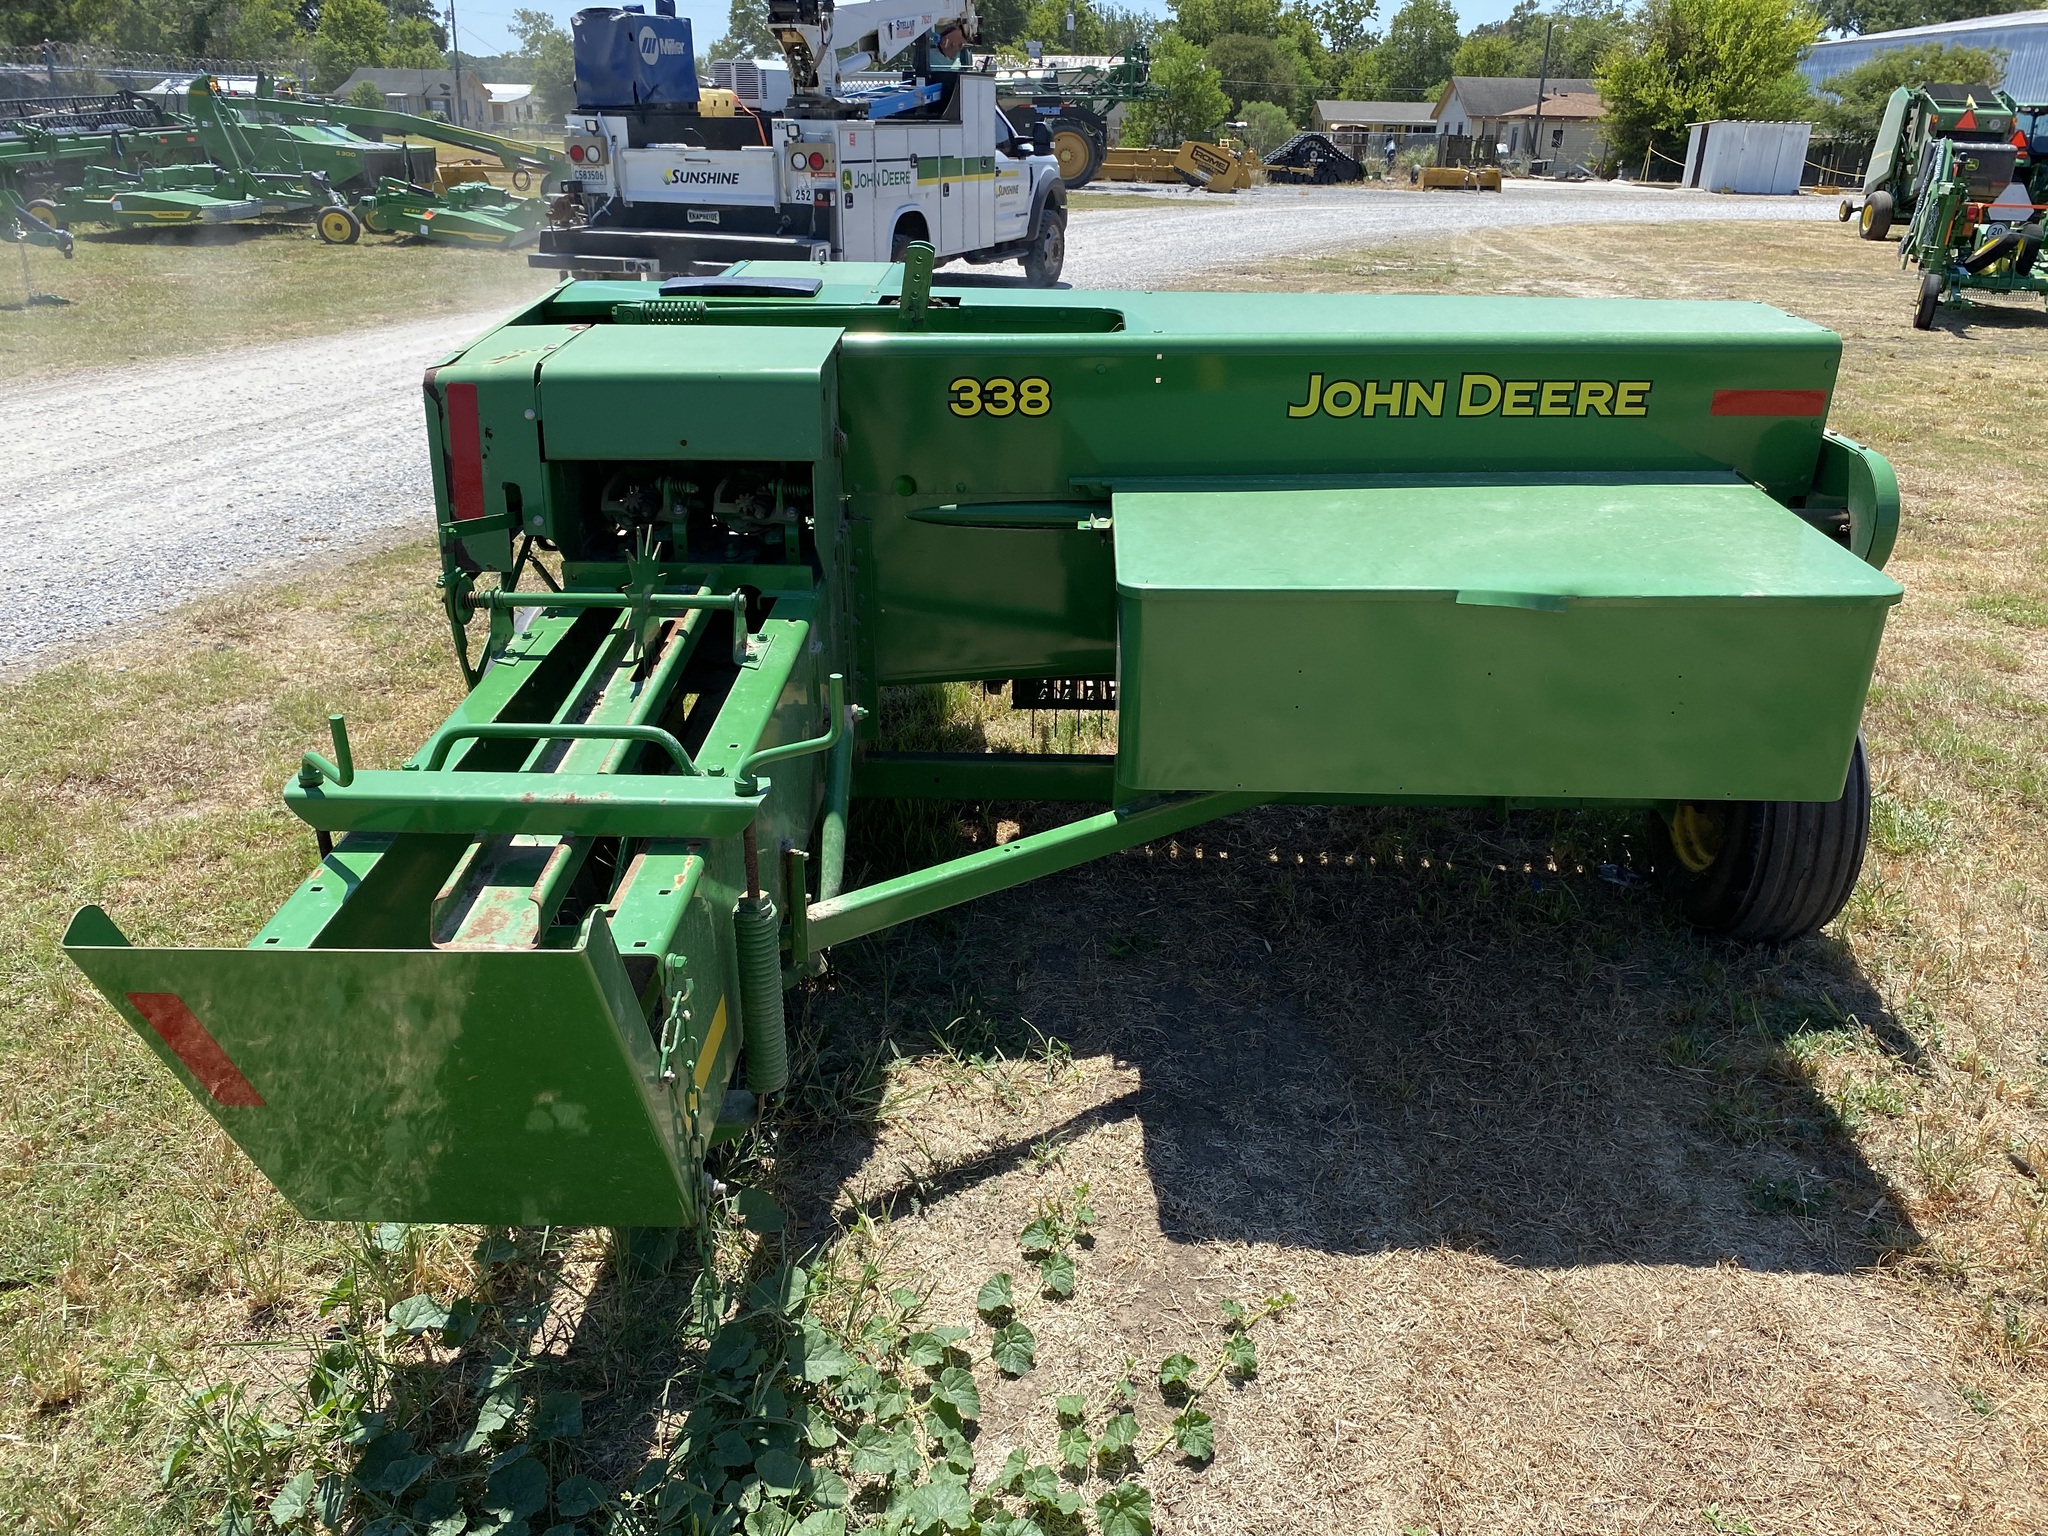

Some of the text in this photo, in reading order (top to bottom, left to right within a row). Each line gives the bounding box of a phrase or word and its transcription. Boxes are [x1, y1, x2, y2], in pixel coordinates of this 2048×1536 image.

[659, 38, 685, 55] Miller
[1195, 150, 1226, 170] ROME
[574, 170, 605, 180] C583506
[671, 169, 740, 185] SUNSHINE
[854, 169, 912, 189] JOHN DEERE
[795, 189, 811, 201] 252
[1991, 226, 2004, 236] 20
[947, 376, 1052, 418] 338
[1286, 372, 1654, 418] JOHN DEERE
